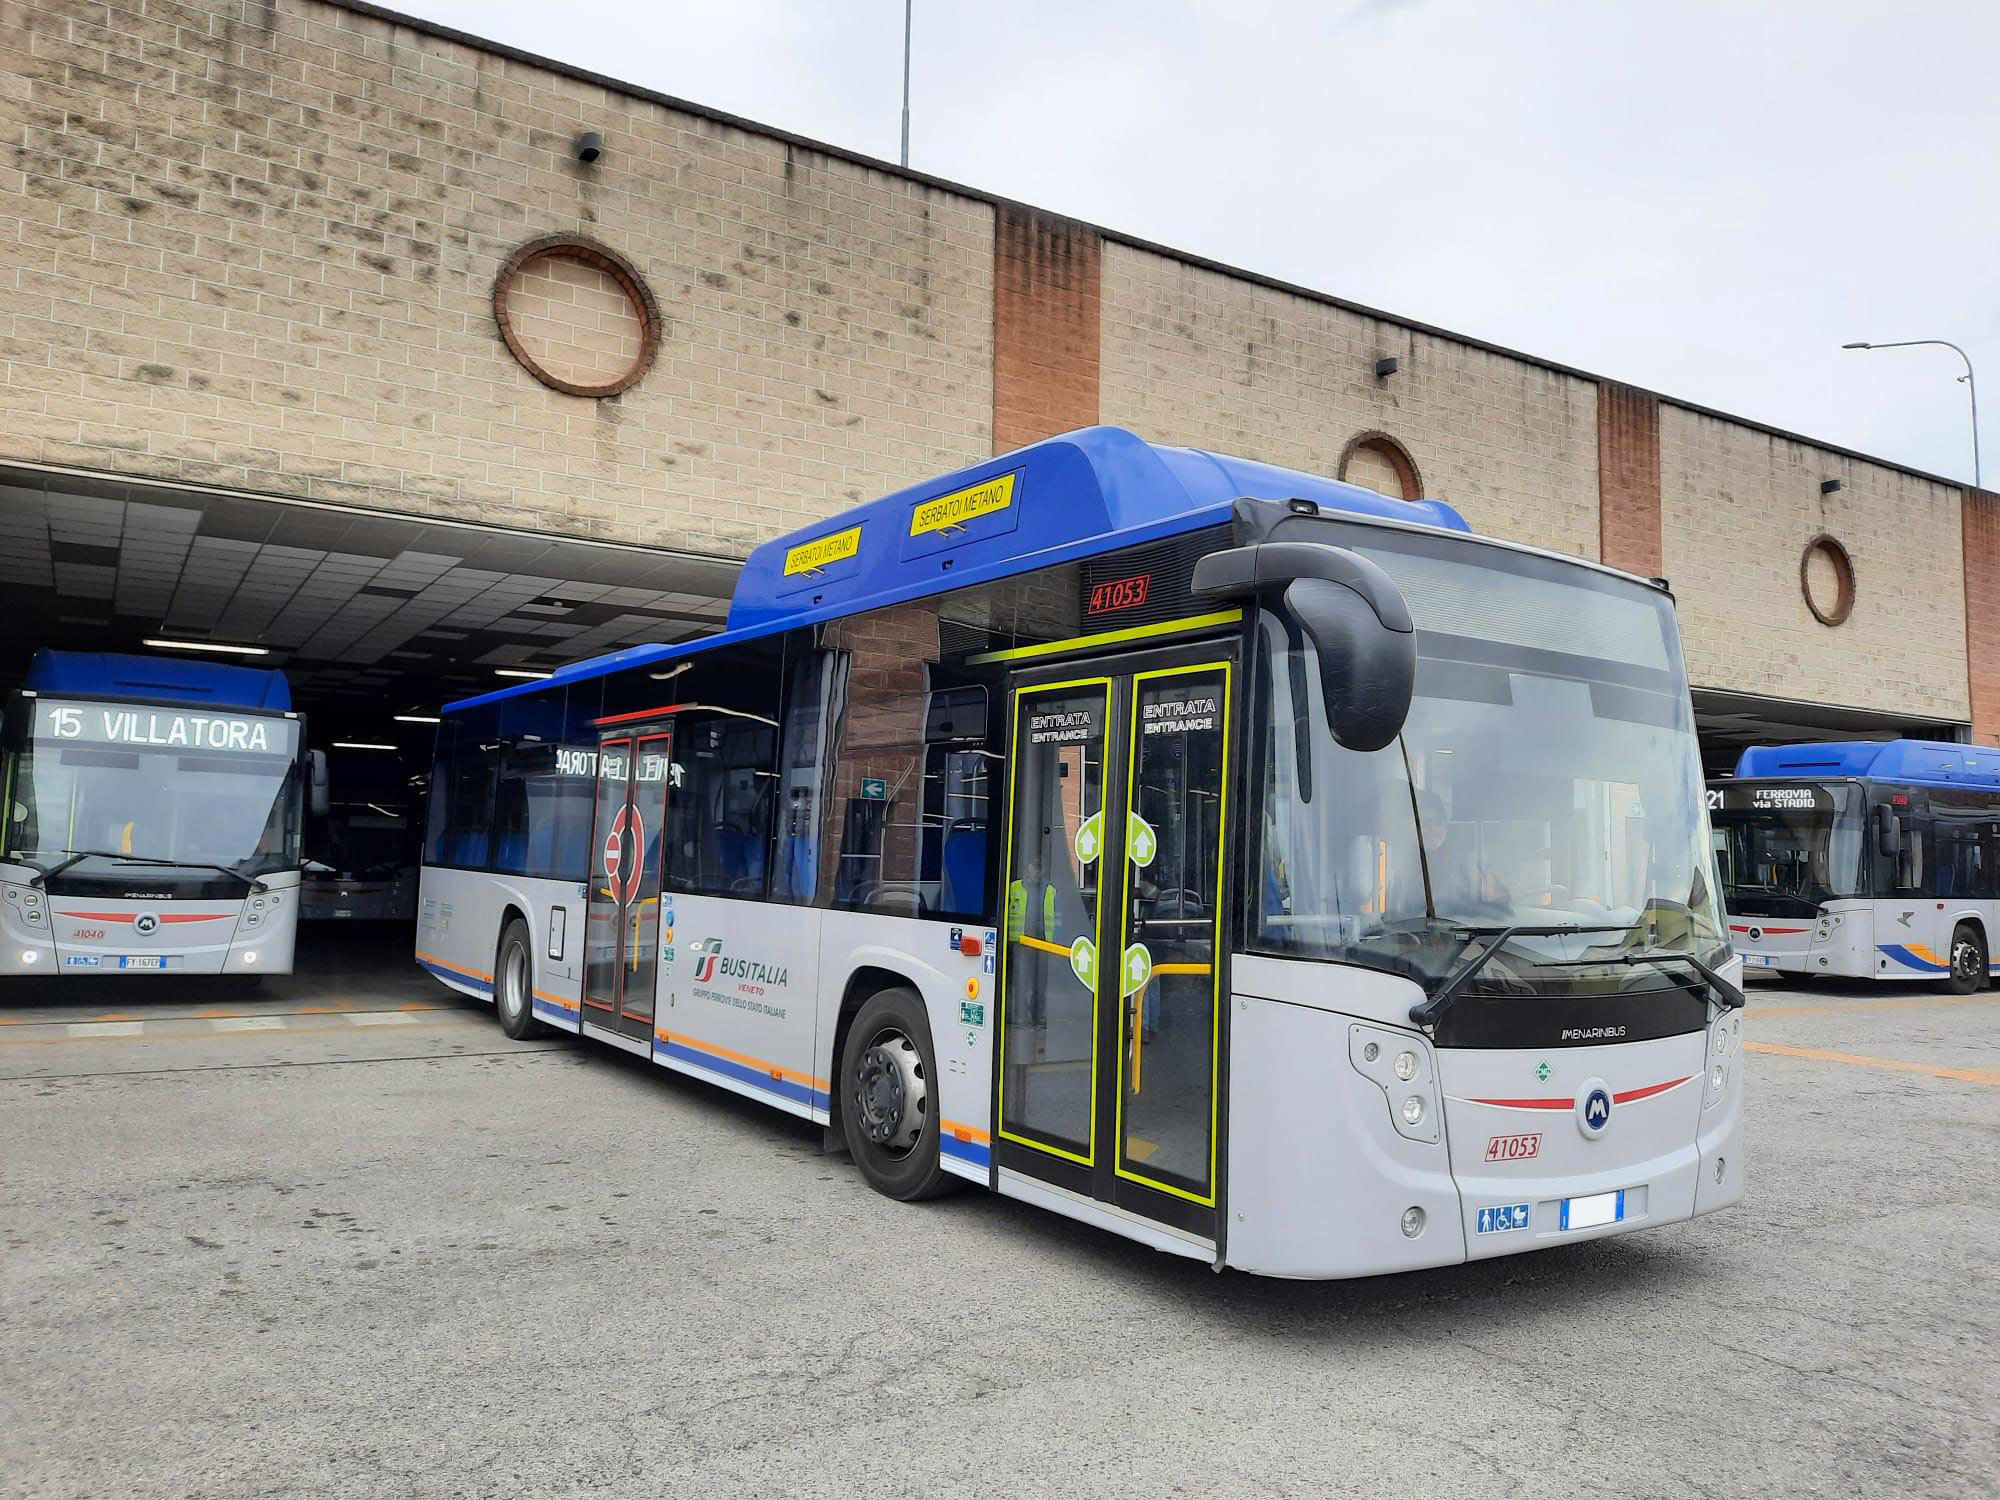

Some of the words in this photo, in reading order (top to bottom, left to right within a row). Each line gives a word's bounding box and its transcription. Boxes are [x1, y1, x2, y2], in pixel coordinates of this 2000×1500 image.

[920, 503, 962, 528] SERBATOI
[963, 485, 1004, 512] METANO
[790, 546, 822, 569] SERBATOI
[823, 535, 853, 557] METANO
[1092, 579, 1145, 610] 41053
[1143, 699, 1216, 719] ENTRATA
[48, 707, 84, 739] 15
[103, 711, 268, 751] VILLATORA
[1031, 712, 1091, 729] ENTRATA
[1144, 718, 1213, 734] ENTRANCE
[1031, 729, 1088, 743] ENTRANCE
[1706, 790, 1724, 810] 21
[1752, 800, 1771, 809] via
[1774, 798, 1815, 808] STADIO
[1756, 789, 1812, 799] FERROVIA
[720, 957, 788, 987] BUSITALIA
[737, 984, 764, 996] VENETO
[1588, 1098, 1607, 1120] M
[1488, 1136, 1538, 1159] 41053
